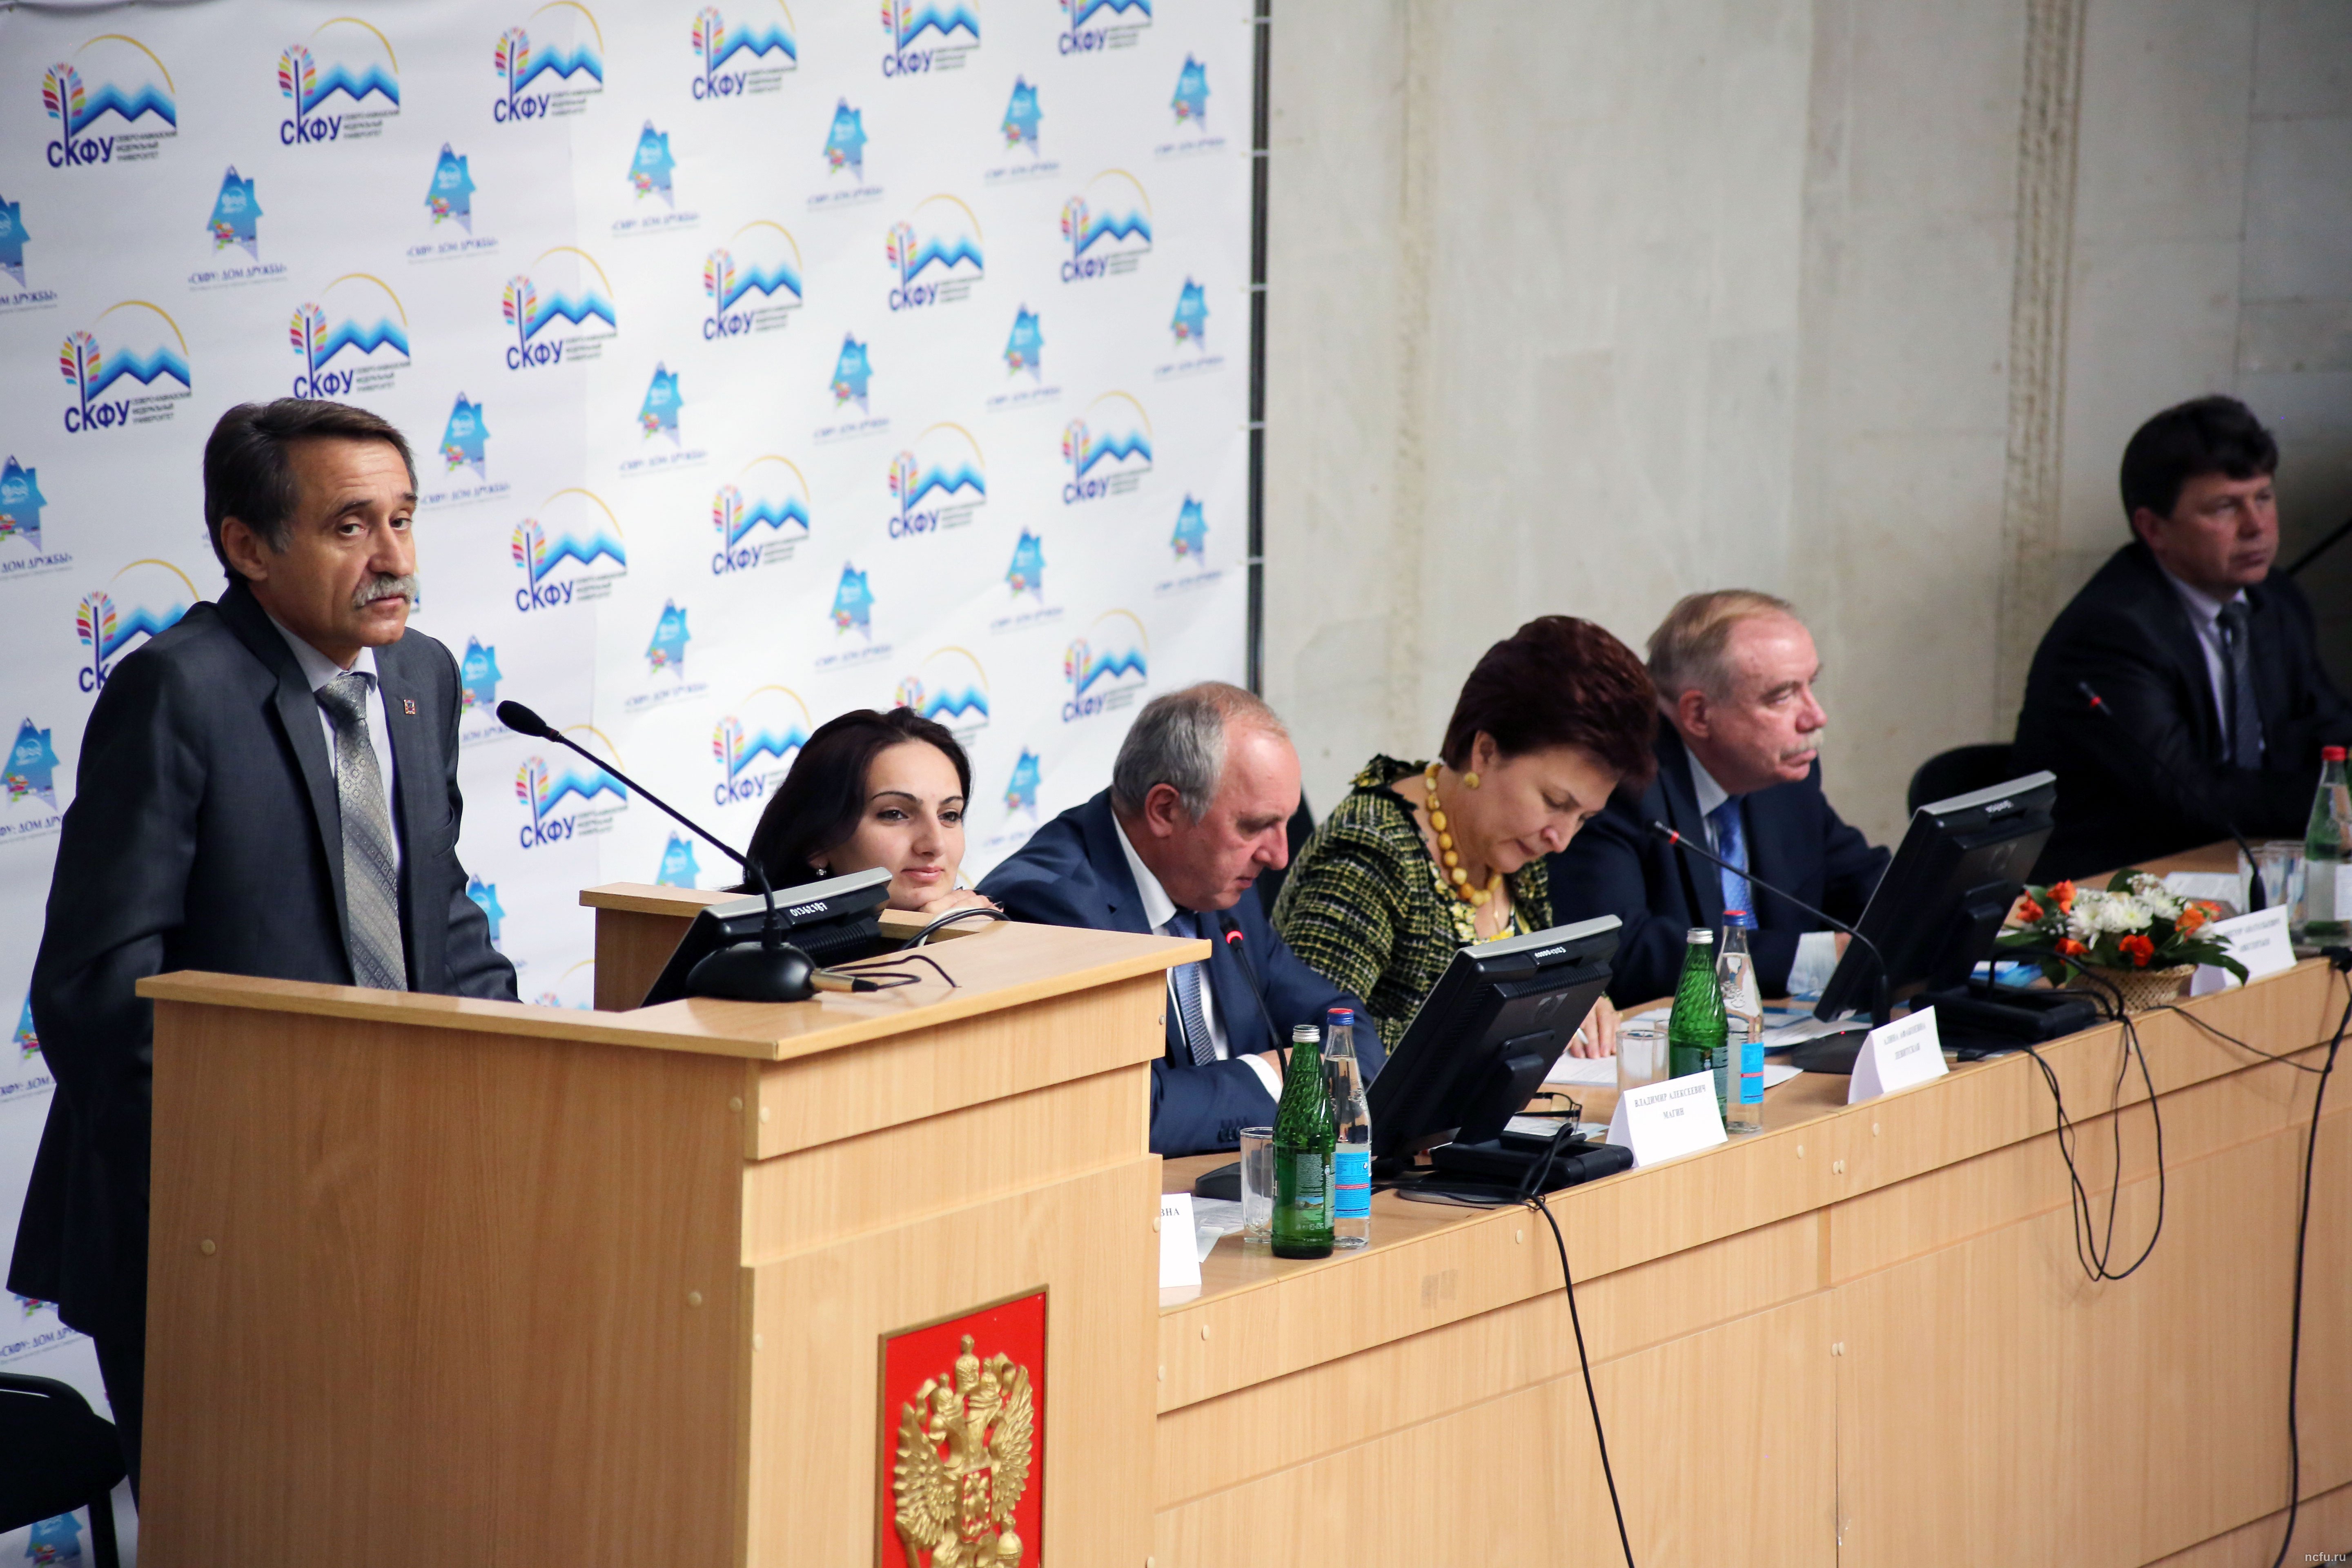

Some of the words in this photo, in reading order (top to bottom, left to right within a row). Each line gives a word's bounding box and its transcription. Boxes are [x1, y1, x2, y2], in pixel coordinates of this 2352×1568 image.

[693, 72, 747, 100] СКФУ
[494, 94, 549, 122] СКФУ
[281, 116, 341, 145] СКФУ
[47, 136, 114, 168] СКФУ
[704, 311, 755, 340] СКФУ
[507, 340, 562, 370] СКФУ
[294, 369, 353, 399] СКФУ
[65, 400, 129, 432] СКФУ
[713, 545, 763, 575] СКФУ
[517, 581, 572, 611] СКФУ
[79, 664, 109, 692] СК
[715, 775, 765, 805] СКФУ
[521, 815, 575, 848] СКФУ
[1634, 1094, 1667, 1107] ВЛАДИМИР
[1669, 1085, 1706, 1100] АЛЕКСЕЕВИЧ
[1663, 1107, 1684, 1119] МАГИН
